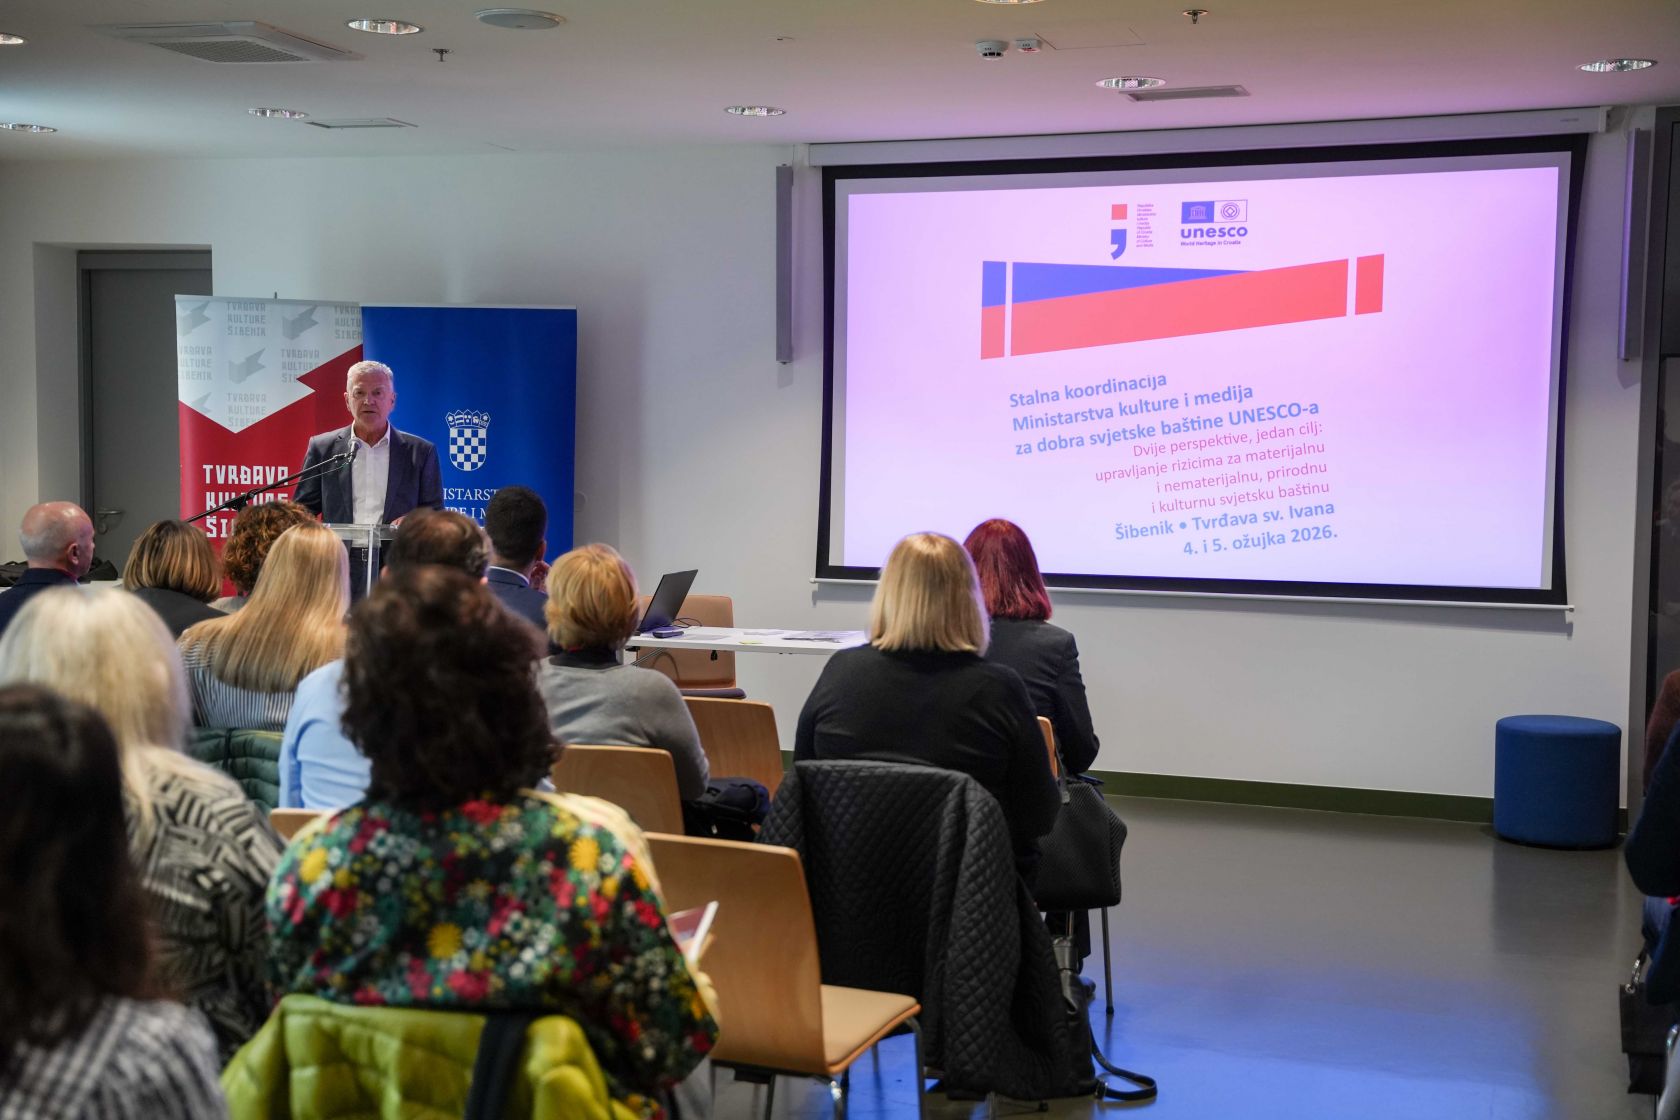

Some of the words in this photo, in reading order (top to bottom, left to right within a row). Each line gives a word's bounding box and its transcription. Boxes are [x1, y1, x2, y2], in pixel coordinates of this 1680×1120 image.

[1180, 226, 1248, 239] unesco
[334, 317, 362, 328] KULTU
[1009, 389, 1060, 407] Stalna
[1064, 374, 1167, 400] koordinacija
[1012, 407, 1114, 431] Ministarstva
[1118, 397, 1179, 417] kulture
[1184, 392, 1190, 407] i
[1194, 385, 1253, 406] medija
[1015, 443, 1032, 455] za
[1037, 435, 1085, 452] dobra
[1089, 424, 1156, 447] svjetske
[1160, 415, 1223, 436] baštine
[1228, 402, 1319, 426] UNESCO-a
[1133, 442, 1167, 457] Dvije
[1170, 432, 1252, 455] perspektive,
[1256, 426, 1294, 443] jedan
[1299, 421, 1323, 436] cilj:
[203, 464, 289, 486] TVRĐAVA
[1095, 462, 1168, 483] upravljanje
[1171, 456, 1223, 472] rizicima
[1227, 454, 1241, 465] za
[1245, 442, 1325, 462] materijalnu
[1156, 481, 1160, 493] i
[1164, 471, 1262, 493] nematerijalnu,
[1267, 462, 1327, 482] prirodnu
[1151, 502, 1156, 513] i
[1159, 497, 1216, 513] kulturnu
[1219, 489, 1274, 506] svjetsku
[1278, 483, 1329, 498] baštinu
[1115, 520, 1174, 540] Šibenik
[1192, 513, 1258, 531] Tvrđava
[1263, 510, 1284, 522] sv.
[1289, 503, 1335, 519] Ivana
[1183, 542, 1199, 555] 4.
[1203, 539, 1208, 553] i
[1212, 538, 1228, 552] 5.
[1232, 531, 1286, 550] ožujka
[1290, 525, 1338, 543] 2026.
